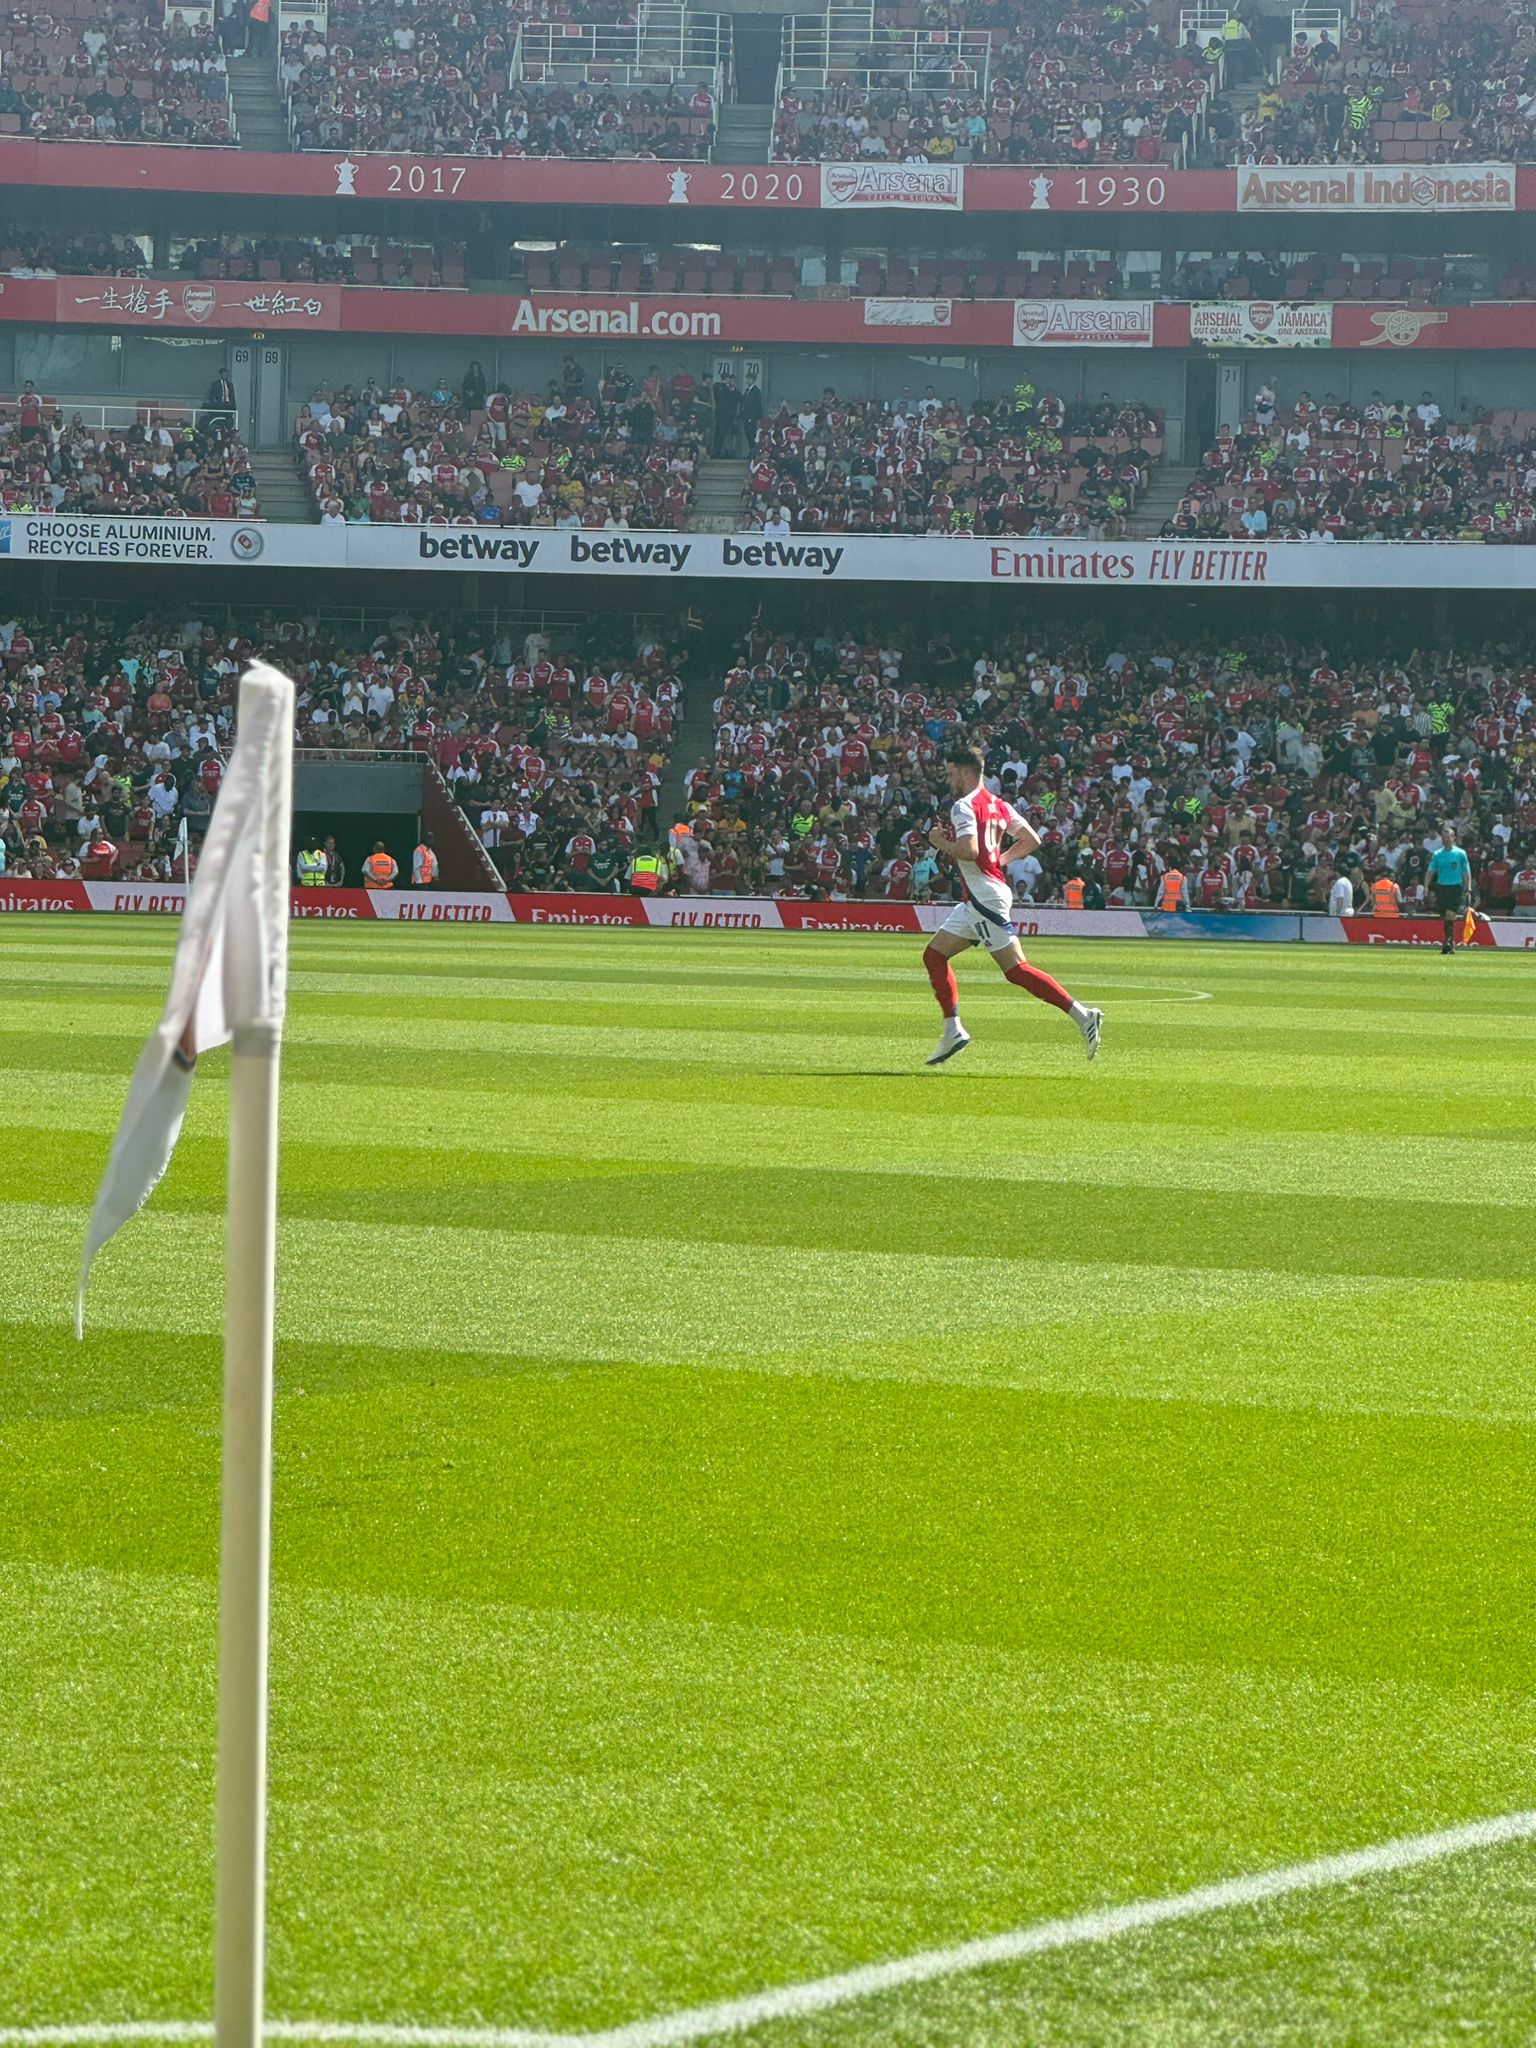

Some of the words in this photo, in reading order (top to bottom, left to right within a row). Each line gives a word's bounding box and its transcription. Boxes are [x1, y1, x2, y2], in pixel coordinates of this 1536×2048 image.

[387, 165, 466, 194] 2017
[720, 173, 803, 201] 2020
[858, 166, 958, 193] Arsenal
[1075, 177, 1166, 206] 1930
[1243, 172, 1355, 204] Arsenal
[511, 299, 721, 336] Arsenal.com
[1049, 304, 1151, 330] Arsenal
[1194, 312, 1243, 326] ARSENAL
[1278, 312, 1328, 327] JAMAICA
[1224, 369, 1237, 383] 71
[26, 521, 101, 539] CHOOSE
[28, 540, 120, 557] RECYCLES
[125, 542, 213, 559] FOREVER.
[418, 531, 540, 568] betway
[570, 534, 692, 572] betway
[722, 538, 844, 575] betway
[990, 546, 1135, 579] Emirates
[1149, 550, 1186, 580] FLY
[1190, 550, 1268, 581] BETTER
